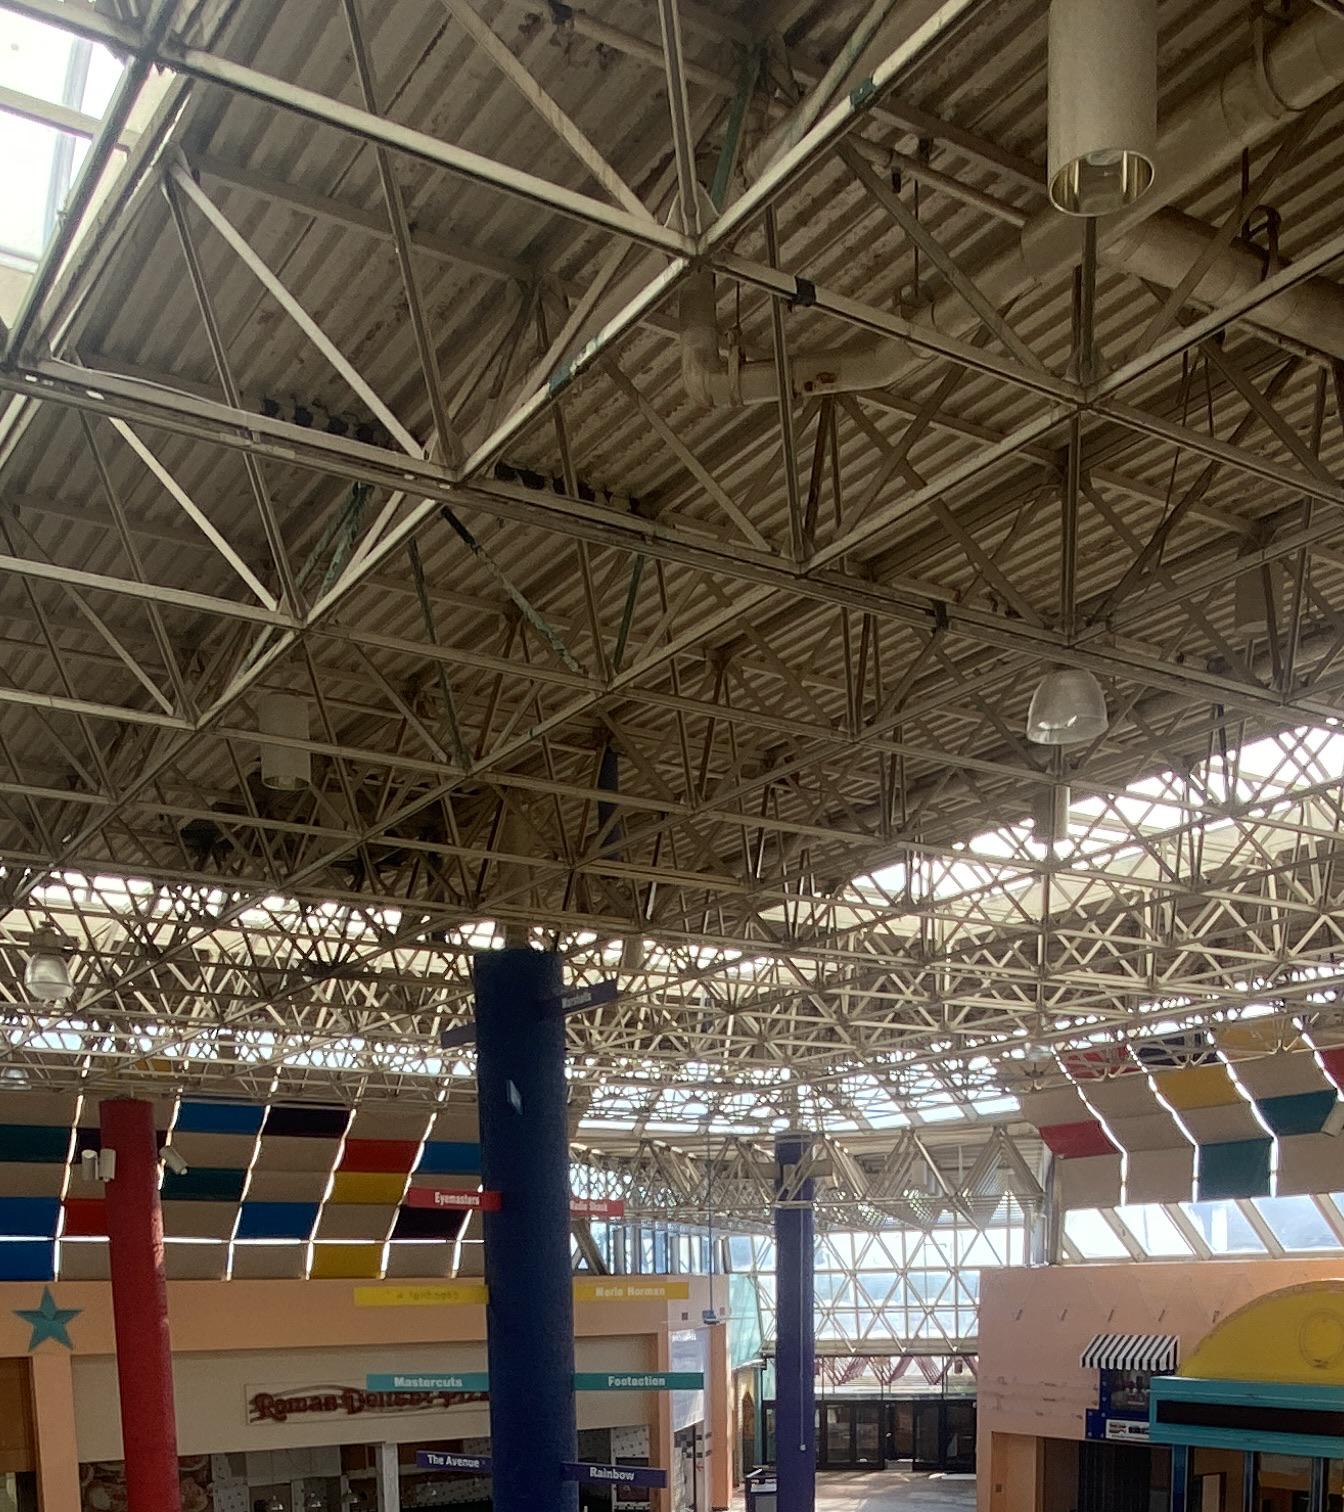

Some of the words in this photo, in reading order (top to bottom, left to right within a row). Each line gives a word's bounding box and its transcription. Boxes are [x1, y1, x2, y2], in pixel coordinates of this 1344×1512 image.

[393, 1376, 463, 1388] Mastercuts
[607, 1375, 666, 1387] Footaction
[426, 1454, 445, 1466] The
[446, 1456, 481, 1469] Avenue
[589, 1466, 635, 1481] Rainbow
